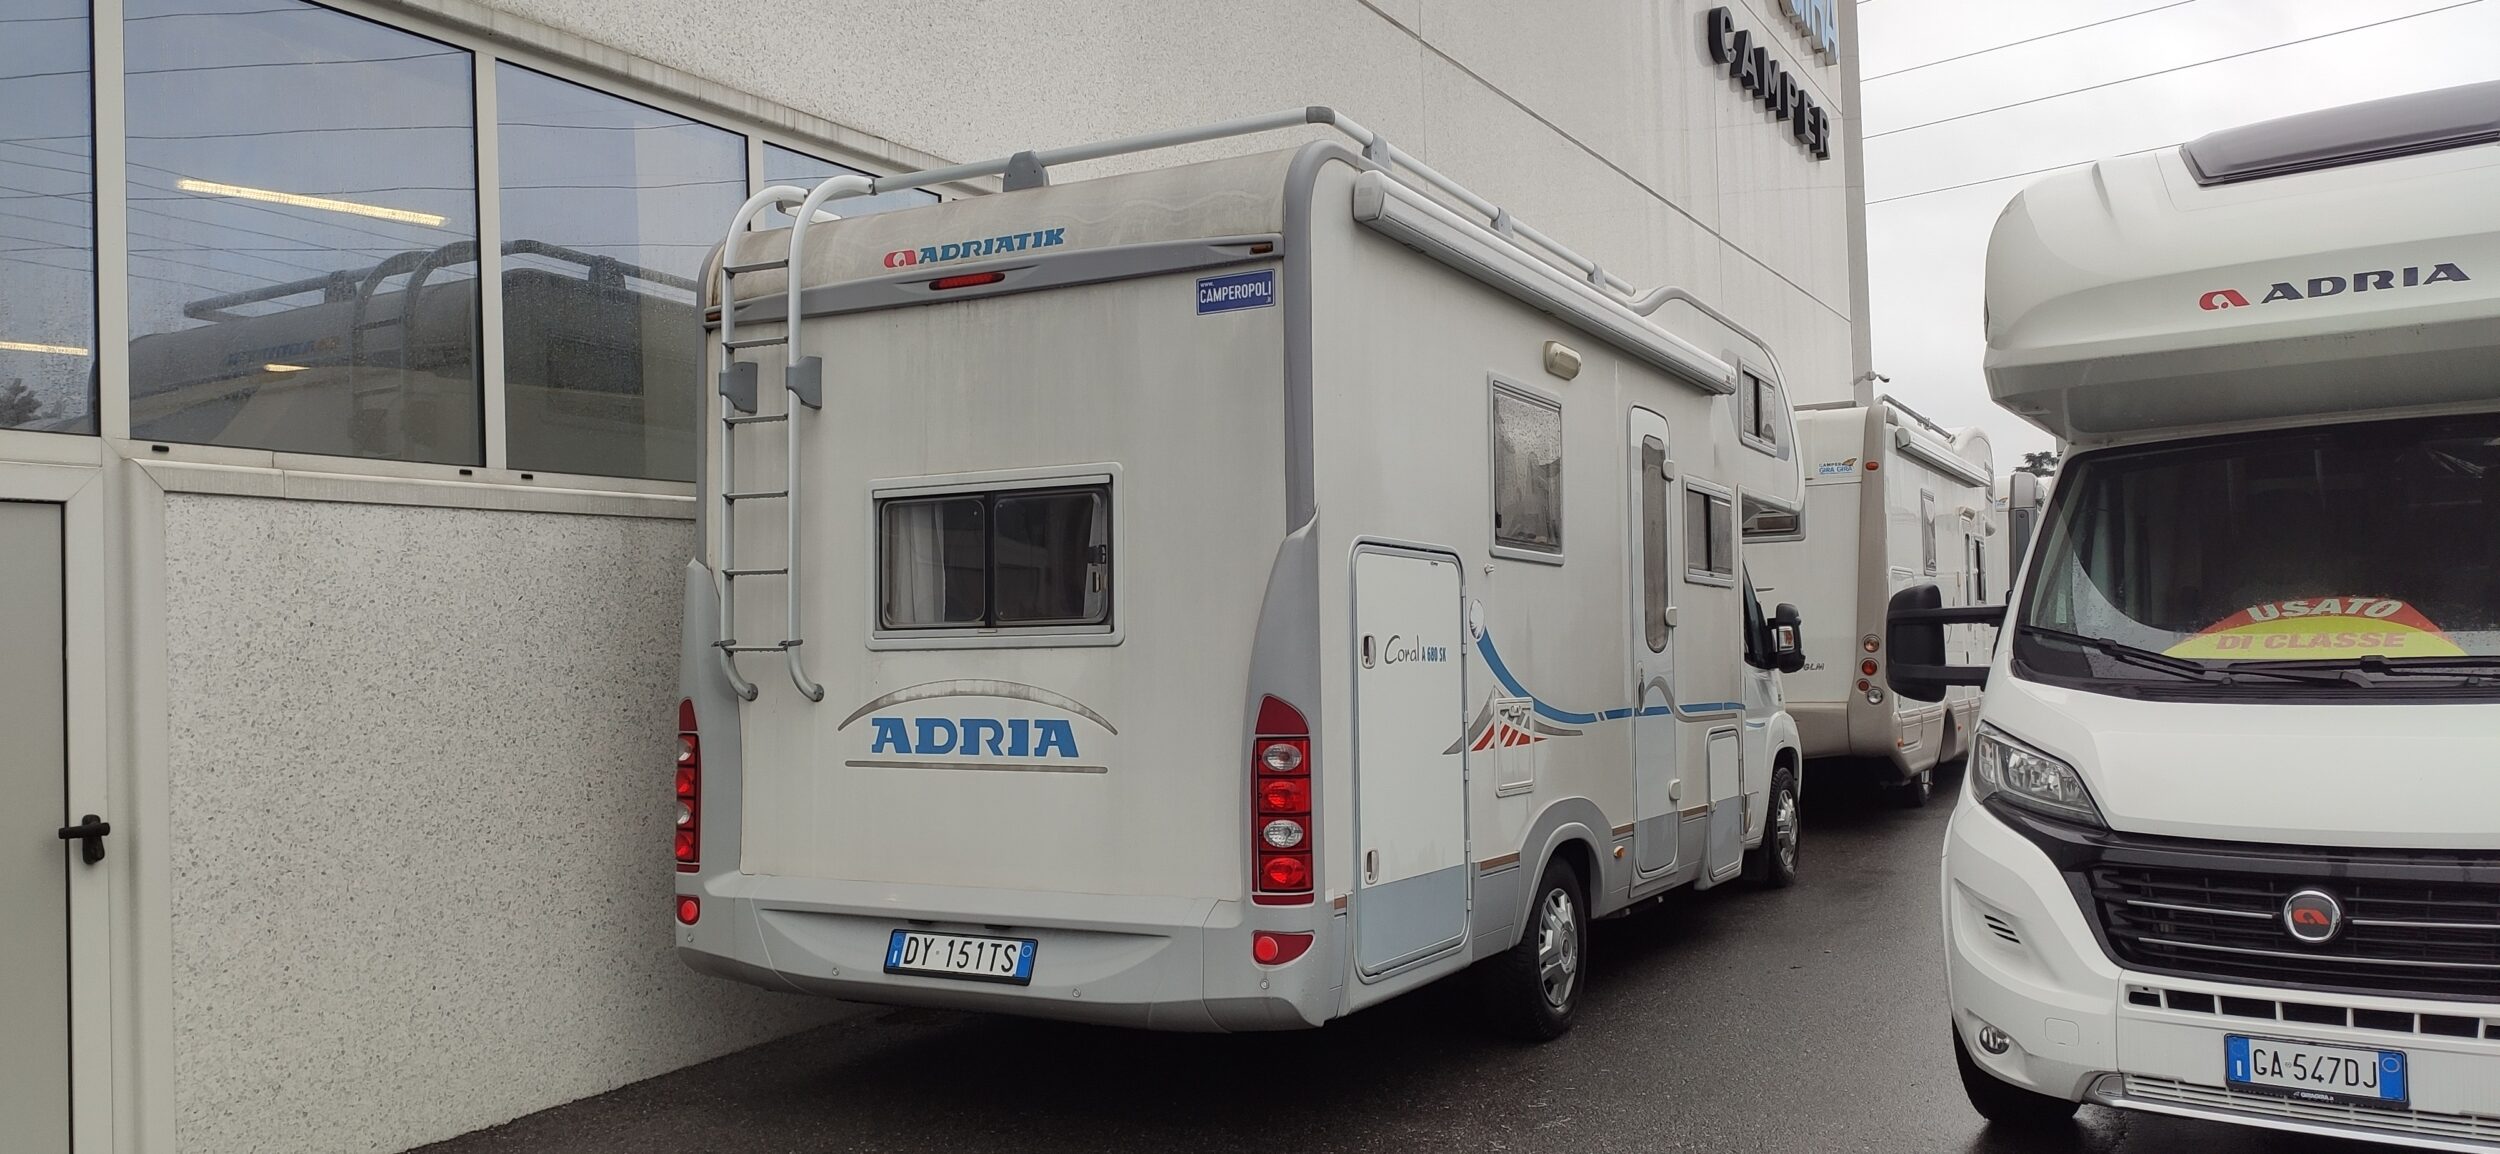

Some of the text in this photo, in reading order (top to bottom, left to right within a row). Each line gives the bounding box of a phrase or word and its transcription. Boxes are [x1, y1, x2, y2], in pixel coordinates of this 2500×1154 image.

[1708, 6, 1831, 160] CAMPER
[919, 228, 1065, 264] ADRIATIK
[1200, 281, 1271, 304] CAMPEROPOLI
[2260, 262, 2471, 304] ADRIA
[2247, 599, 2402, 622] USATO
[1385, 634, 1420, 664] Coral
[2216, 631, 2406, 650] DI CLASSE
[871, 717, 1079, 758] ADRIA
[903, 937, 935, 965] DY
[946, 940, 1017, 972] 151TS
[2253, 1049, 2283, 1078] GA
[2293, 1054, 2378, 1088] 547DJ
